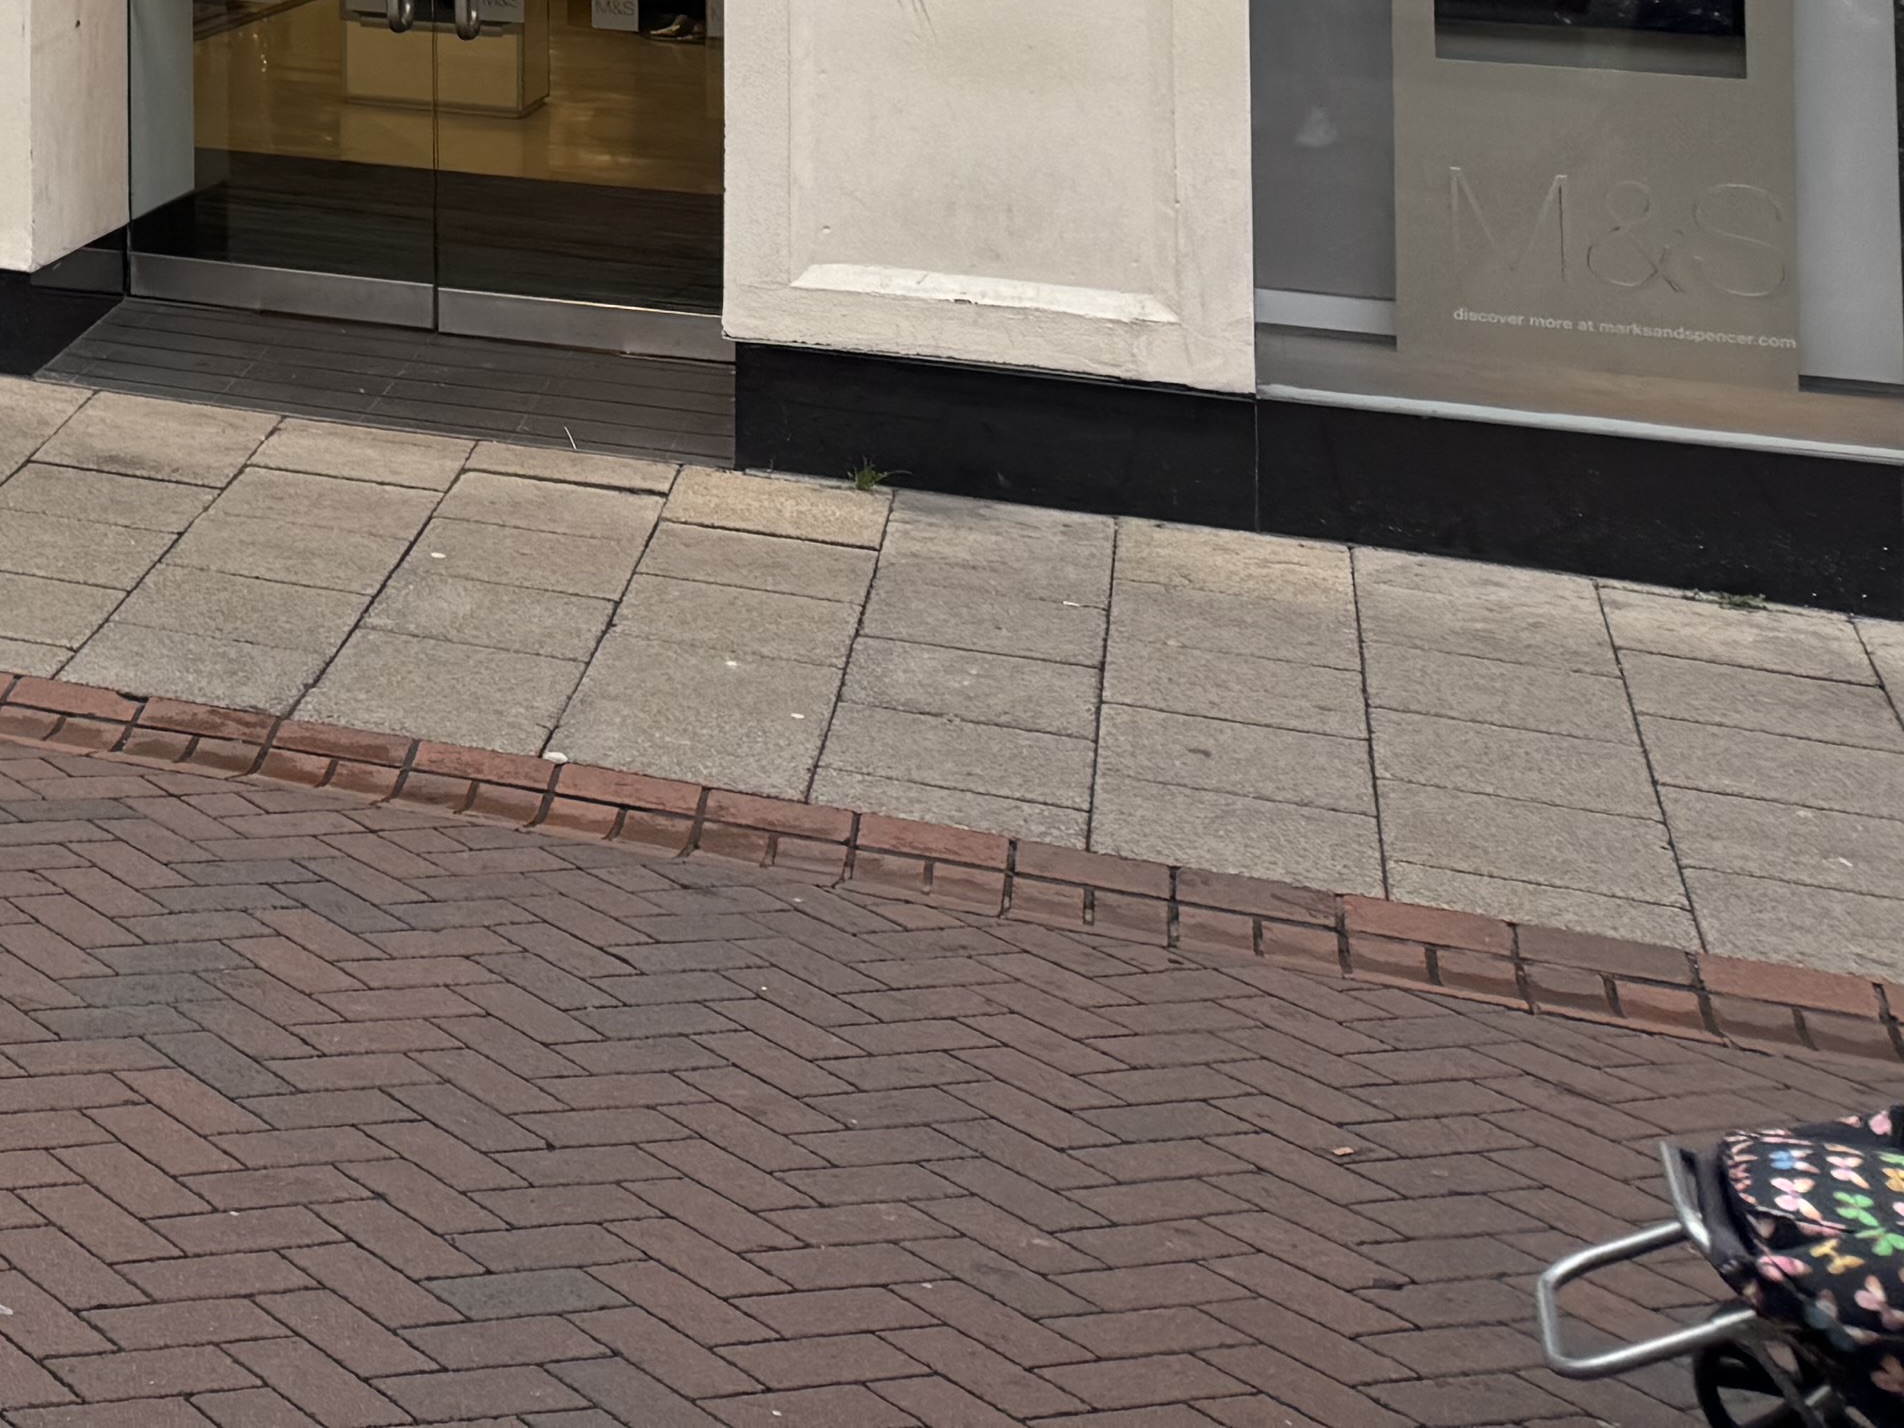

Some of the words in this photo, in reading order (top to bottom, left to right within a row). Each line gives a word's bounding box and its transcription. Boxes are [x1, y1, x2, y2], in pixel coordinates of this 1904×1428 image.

[1449, 166, 1787, 297] M&S
[1453, 307, 1525, 326] discover
[1530, 315, 1573, 330] more
[1577, 320, 1595, 332] at
[1599, 320, 1797, 349] marksandspencer.com
